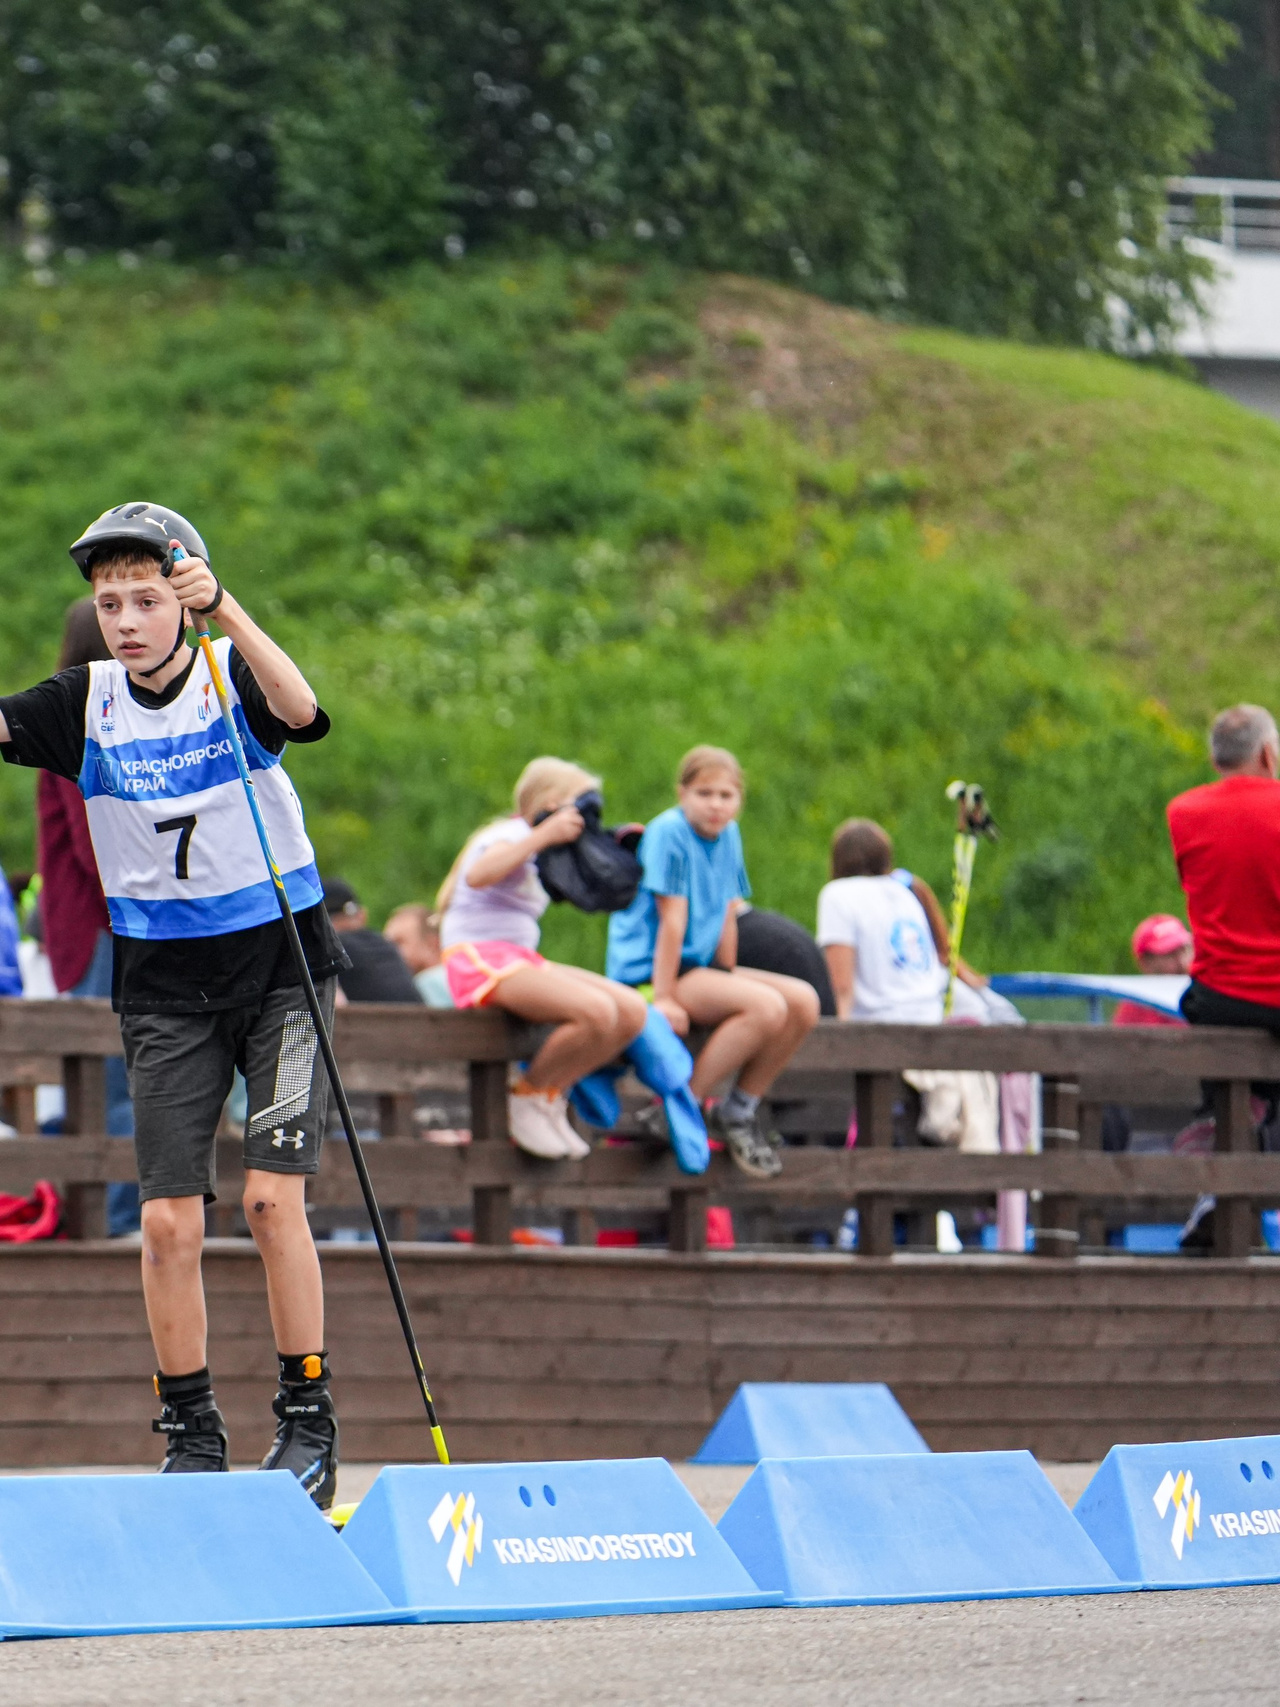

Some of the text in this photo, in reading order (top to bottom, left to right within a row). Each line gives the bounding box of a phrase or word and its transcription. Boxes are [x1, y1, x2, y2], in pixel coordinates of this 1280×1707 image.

[123, 772, 167, 793] КРАЙ
[153, 813, 198, 880] 7
[285, 1404, 320, 1413] SPINE
[492, 1531, 697, 1565] KRASINDORSTROY
